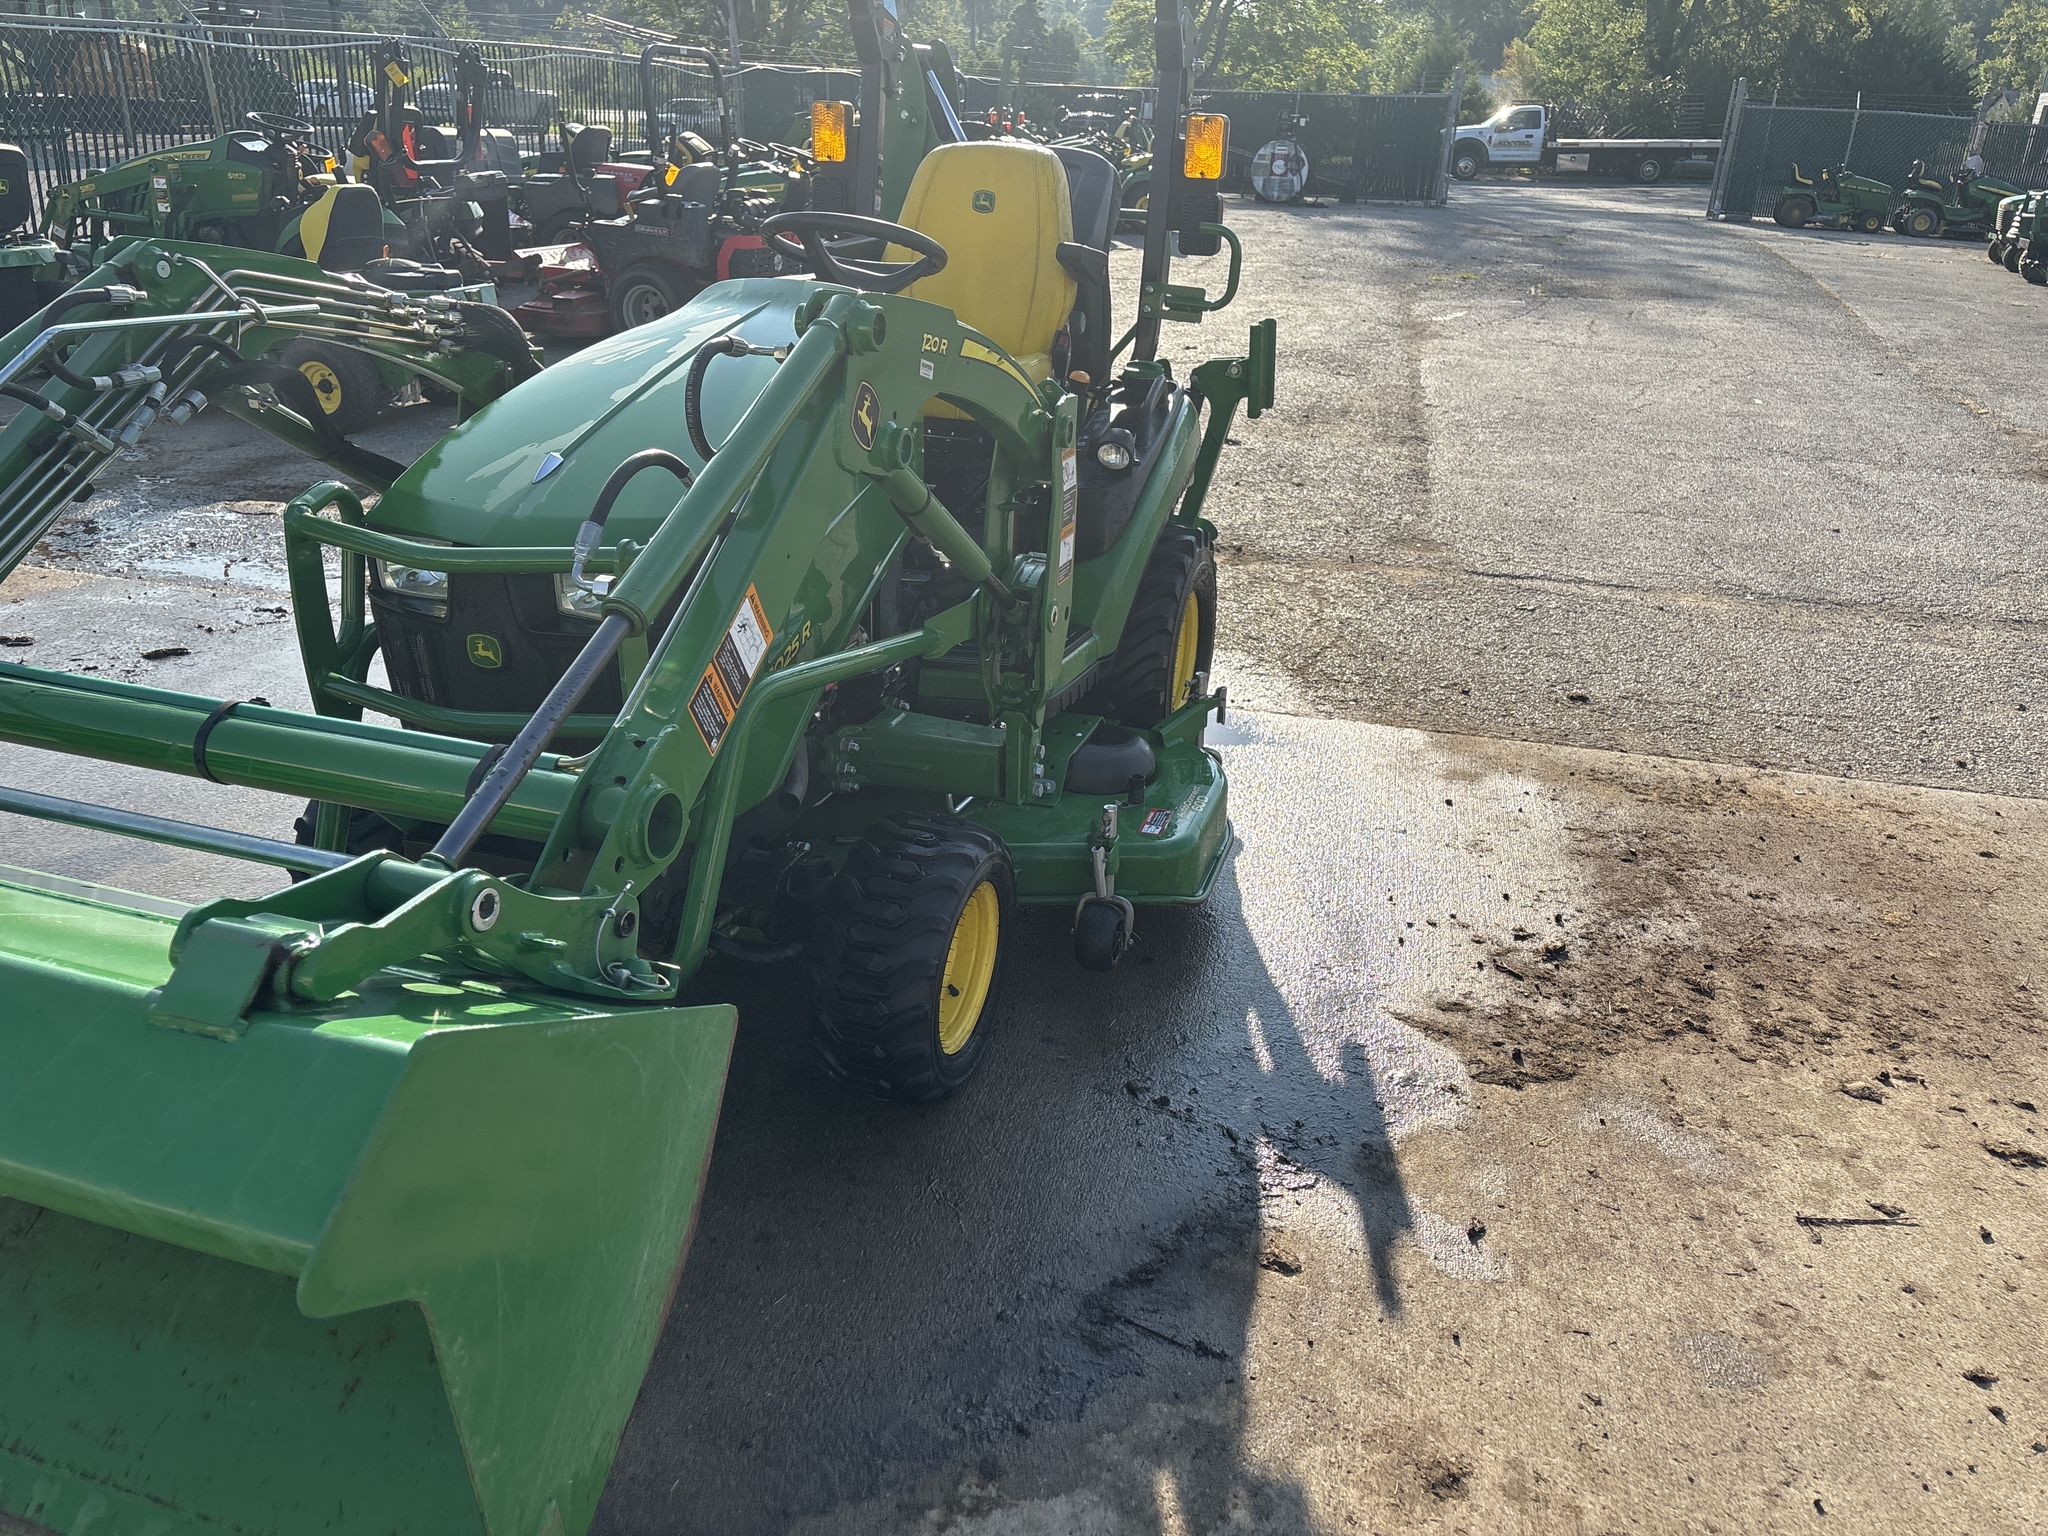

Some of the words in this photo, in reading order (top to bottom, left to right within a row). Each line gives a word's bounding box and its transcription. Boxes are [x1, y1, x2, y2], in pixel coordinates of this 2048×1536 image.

[635, 226, 667, 234] GRAVELY
[752, 601, 771, 638] WARNING
[768, 633, 801, 672] 025
[712, 683, 731, 718] WARNING
